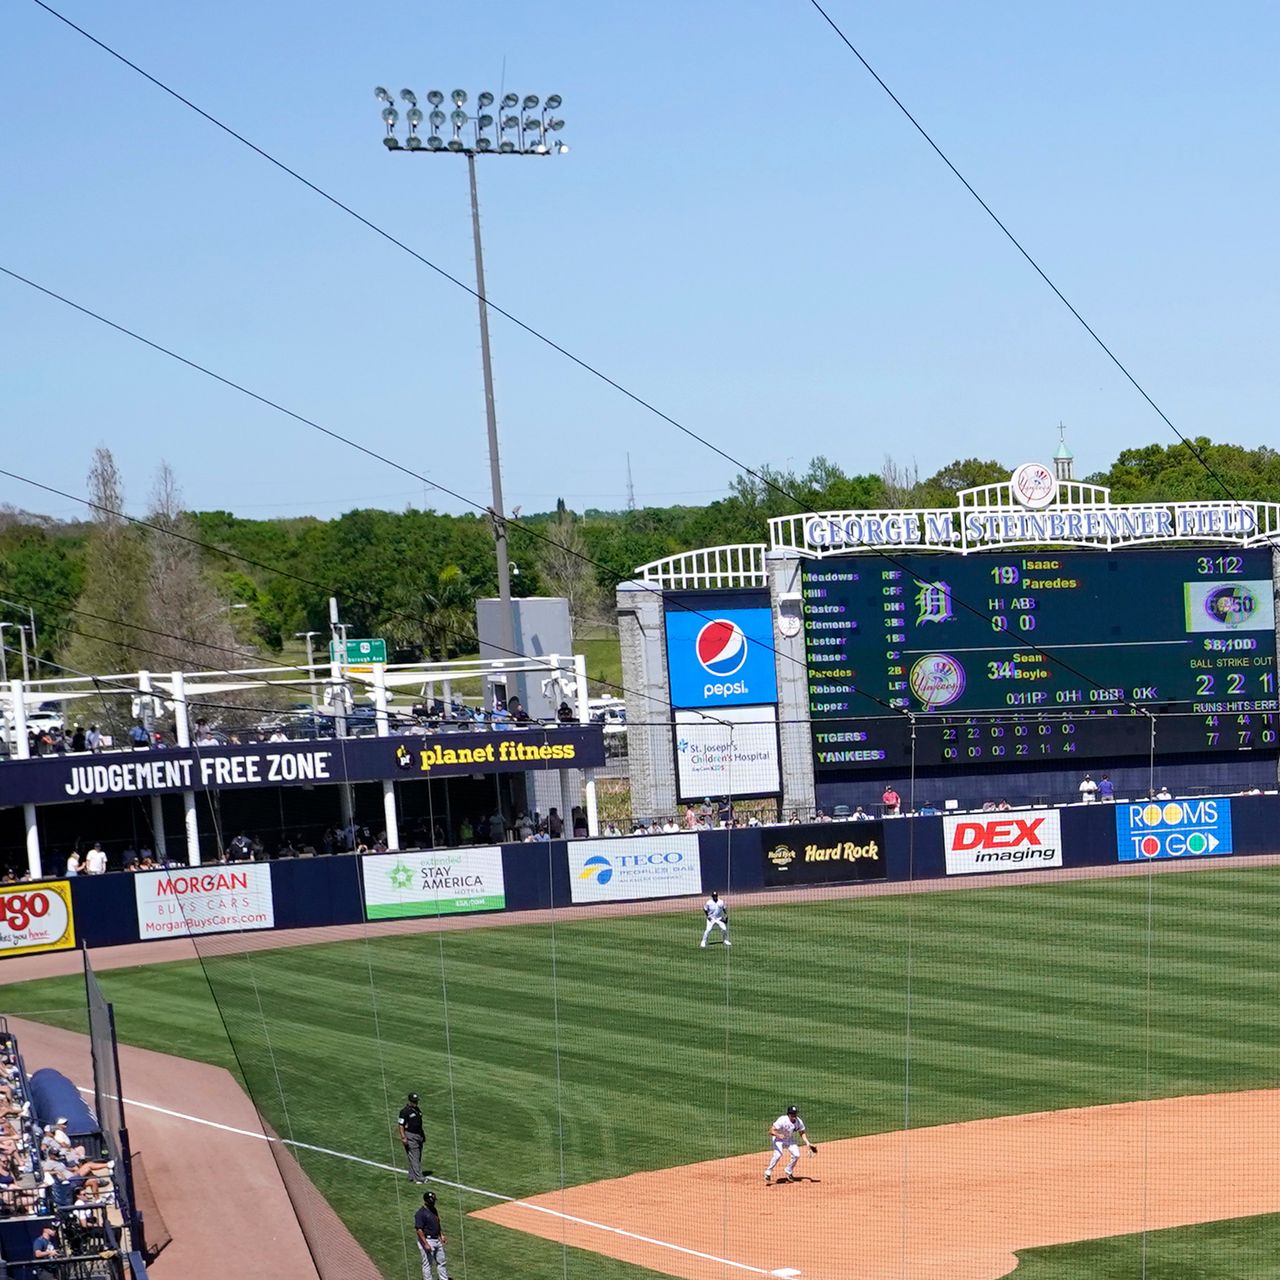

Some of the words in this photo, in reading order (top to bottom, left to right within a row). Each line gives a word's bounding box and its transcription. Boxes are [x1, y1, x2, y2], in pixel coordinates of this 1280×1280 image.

[808, 516, 920, 546] GEORGE
[927, 514, 960, 542] M.
[967, 510, 1174, 541] STEINBRENNER
[1178, 508, 1256, 536] FIELD
[1022, 560, 1062, 570] Isaac
[802, 572, 859, 582] Meadows
[1023, 579, 1081, 589] Paredes
[804, 605, 845, 614] Castro
[1011, 598, 1036, 610] AB
[806, 621, 857, 629] Clemens
[807, 637, 847, 645] Lester
[808, 653, 847, 662] Haase
[1013, 653, 1047, 662] Sean
[1190, 659, 1213, 669] BALL
[1216, 657, 1249, 667] STRIKE
[1253, 656, 1273, 666] OUT
[809, 669, 855, 678] Paredes
[1014, 669, 1051, 680] Boyle
[704, 680, 746, 699] pepsi
[810, 685, 855, 694] Robson
[811, 702, 848, 712] Lopez
[1193, 702, 1226, 712] RUNS
[1226, 701, 1254, 711] HITS
[1254, 700, 1279, 710] ERR
[816, 732, 867, 742] TIGERS
[690, 744, 702, 753] St.
[704, 742, 738, 754] Joseph's
[420, 742, 495, 770] planet
[498, 741, 576, 761] fitness
[691, 753, 733, 764] Children's
[734, 751, 770, 762] Hospital
[817, 750, 885, 762] YANKEES
[65, 760, 193, 796] JUDGEMENT
[201, 755, 262, 785] FREE
[267, 752, 331, 782] ZONE
[1129, 800, 1218, 828] ROOMS
[951, 817, 1045, 851] DEX
[805, 842, 843, 862] Hard
[843, 840, 879, 862] Rock
[1131, 833, 1160, 859] TO
[1166, 832, 1207, 856] GO
[420, 855, 462, 866] extended
[615, 852, 683, 868] TECO
[975, 848, 1056, 863] imaging
[420, 867, 452, 878] STAY
[157, 872, 248, 897] MORGAN
[422, 875, 484, 890] AMERICA
[158, 902, 196, 915] BUYS
[207, 897, 250, 910] CARS
[146, 912, 267, 933] MorganBuysCars.com
